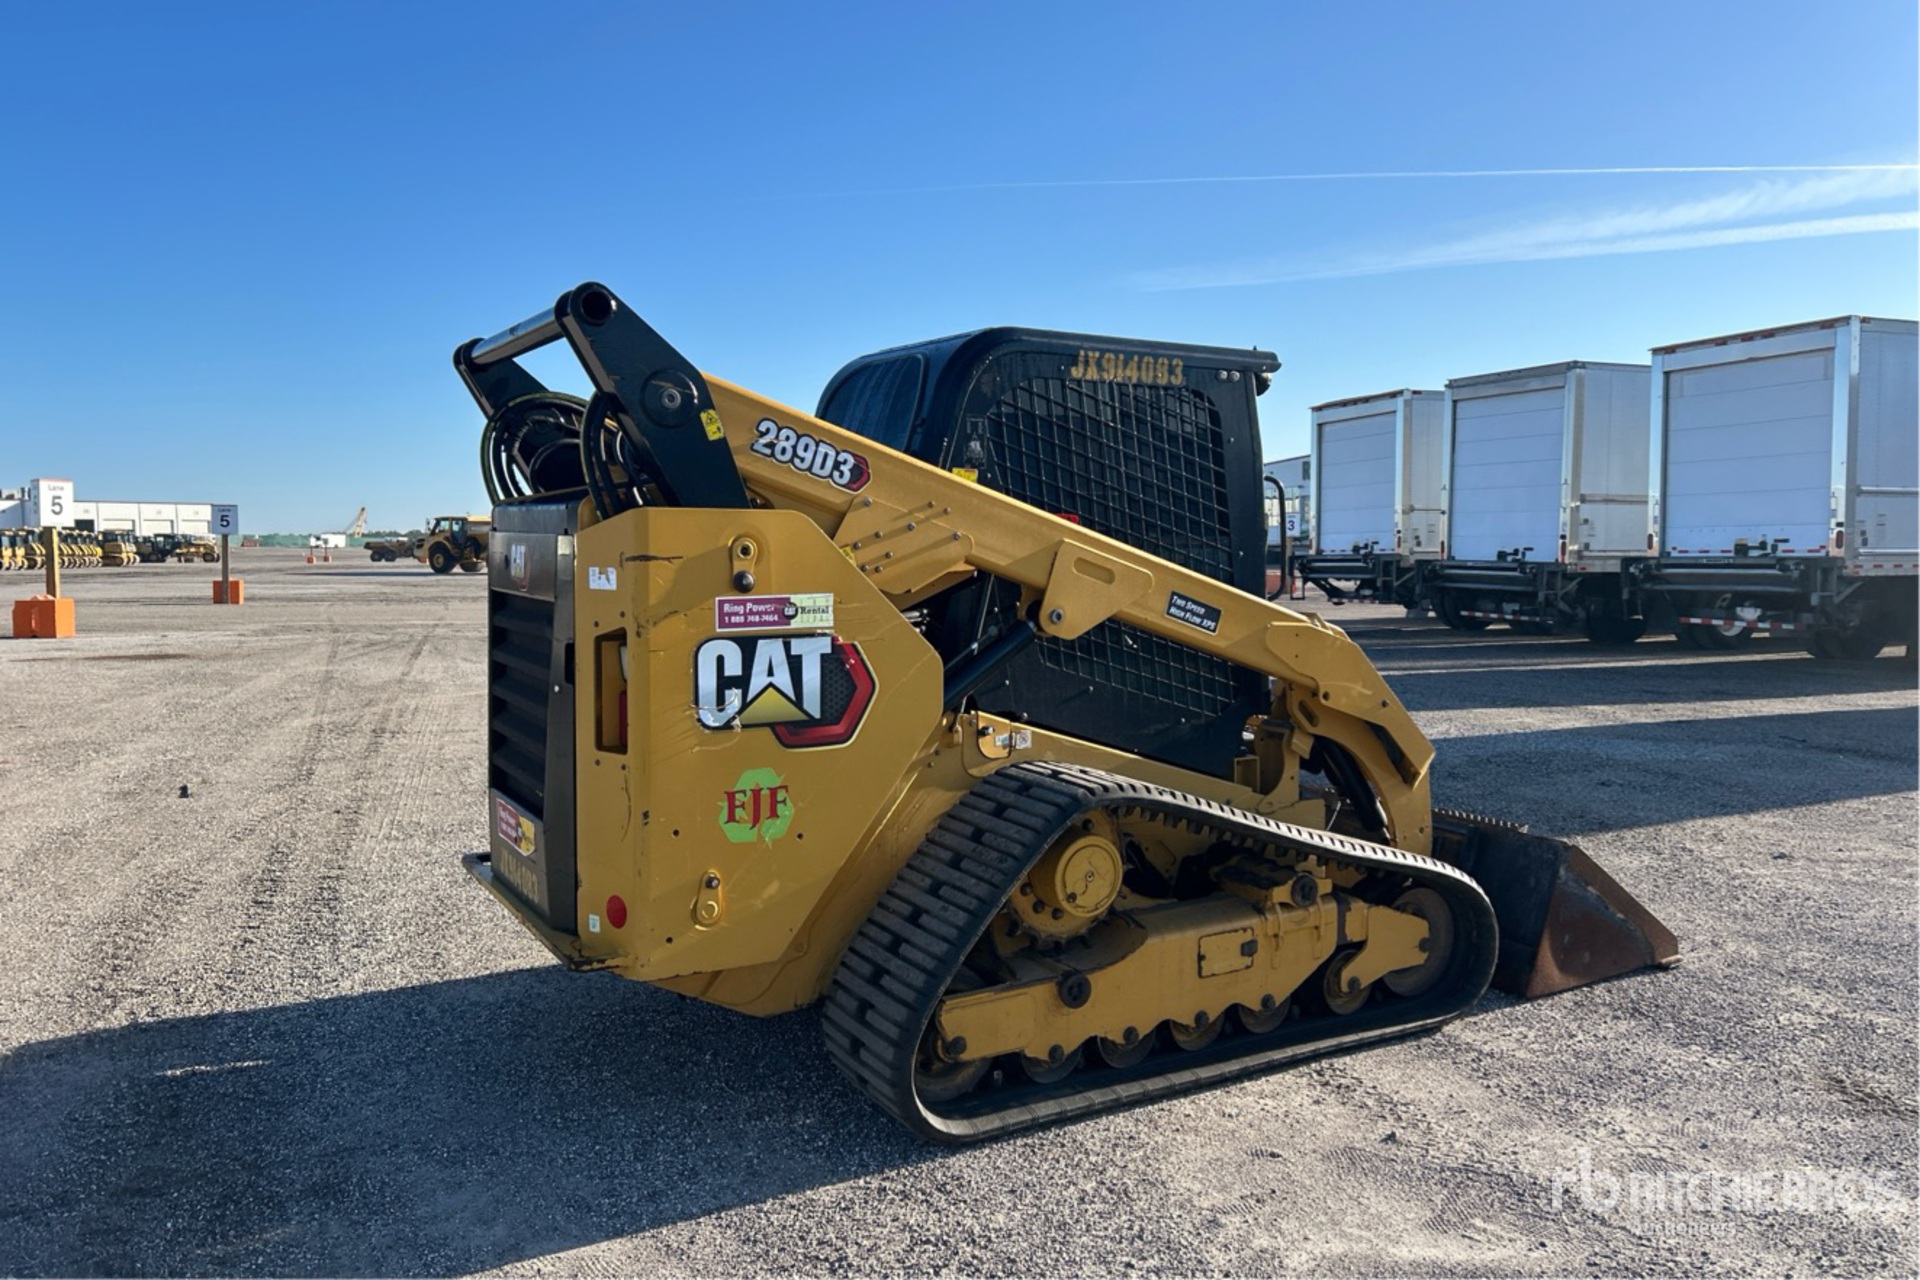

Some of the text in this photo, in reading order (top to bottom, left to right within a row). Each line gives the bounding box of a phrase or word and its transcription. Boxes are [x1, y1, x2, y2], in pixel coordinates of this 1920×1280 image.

[1070, 349, 1184, 385] JX914083
[752, 420, 855, 486] 289D3
[51, 495, 63, 515] 5
[220, 514, 230, 528] 5
[1288, 520, 1295, 531] 3
[723, 602, 775, 614] Ring Power
[800, 606, 829, 615] Rental
[698, 636, 832, 727] CAT
[724, 785, 788, 830] FJF
